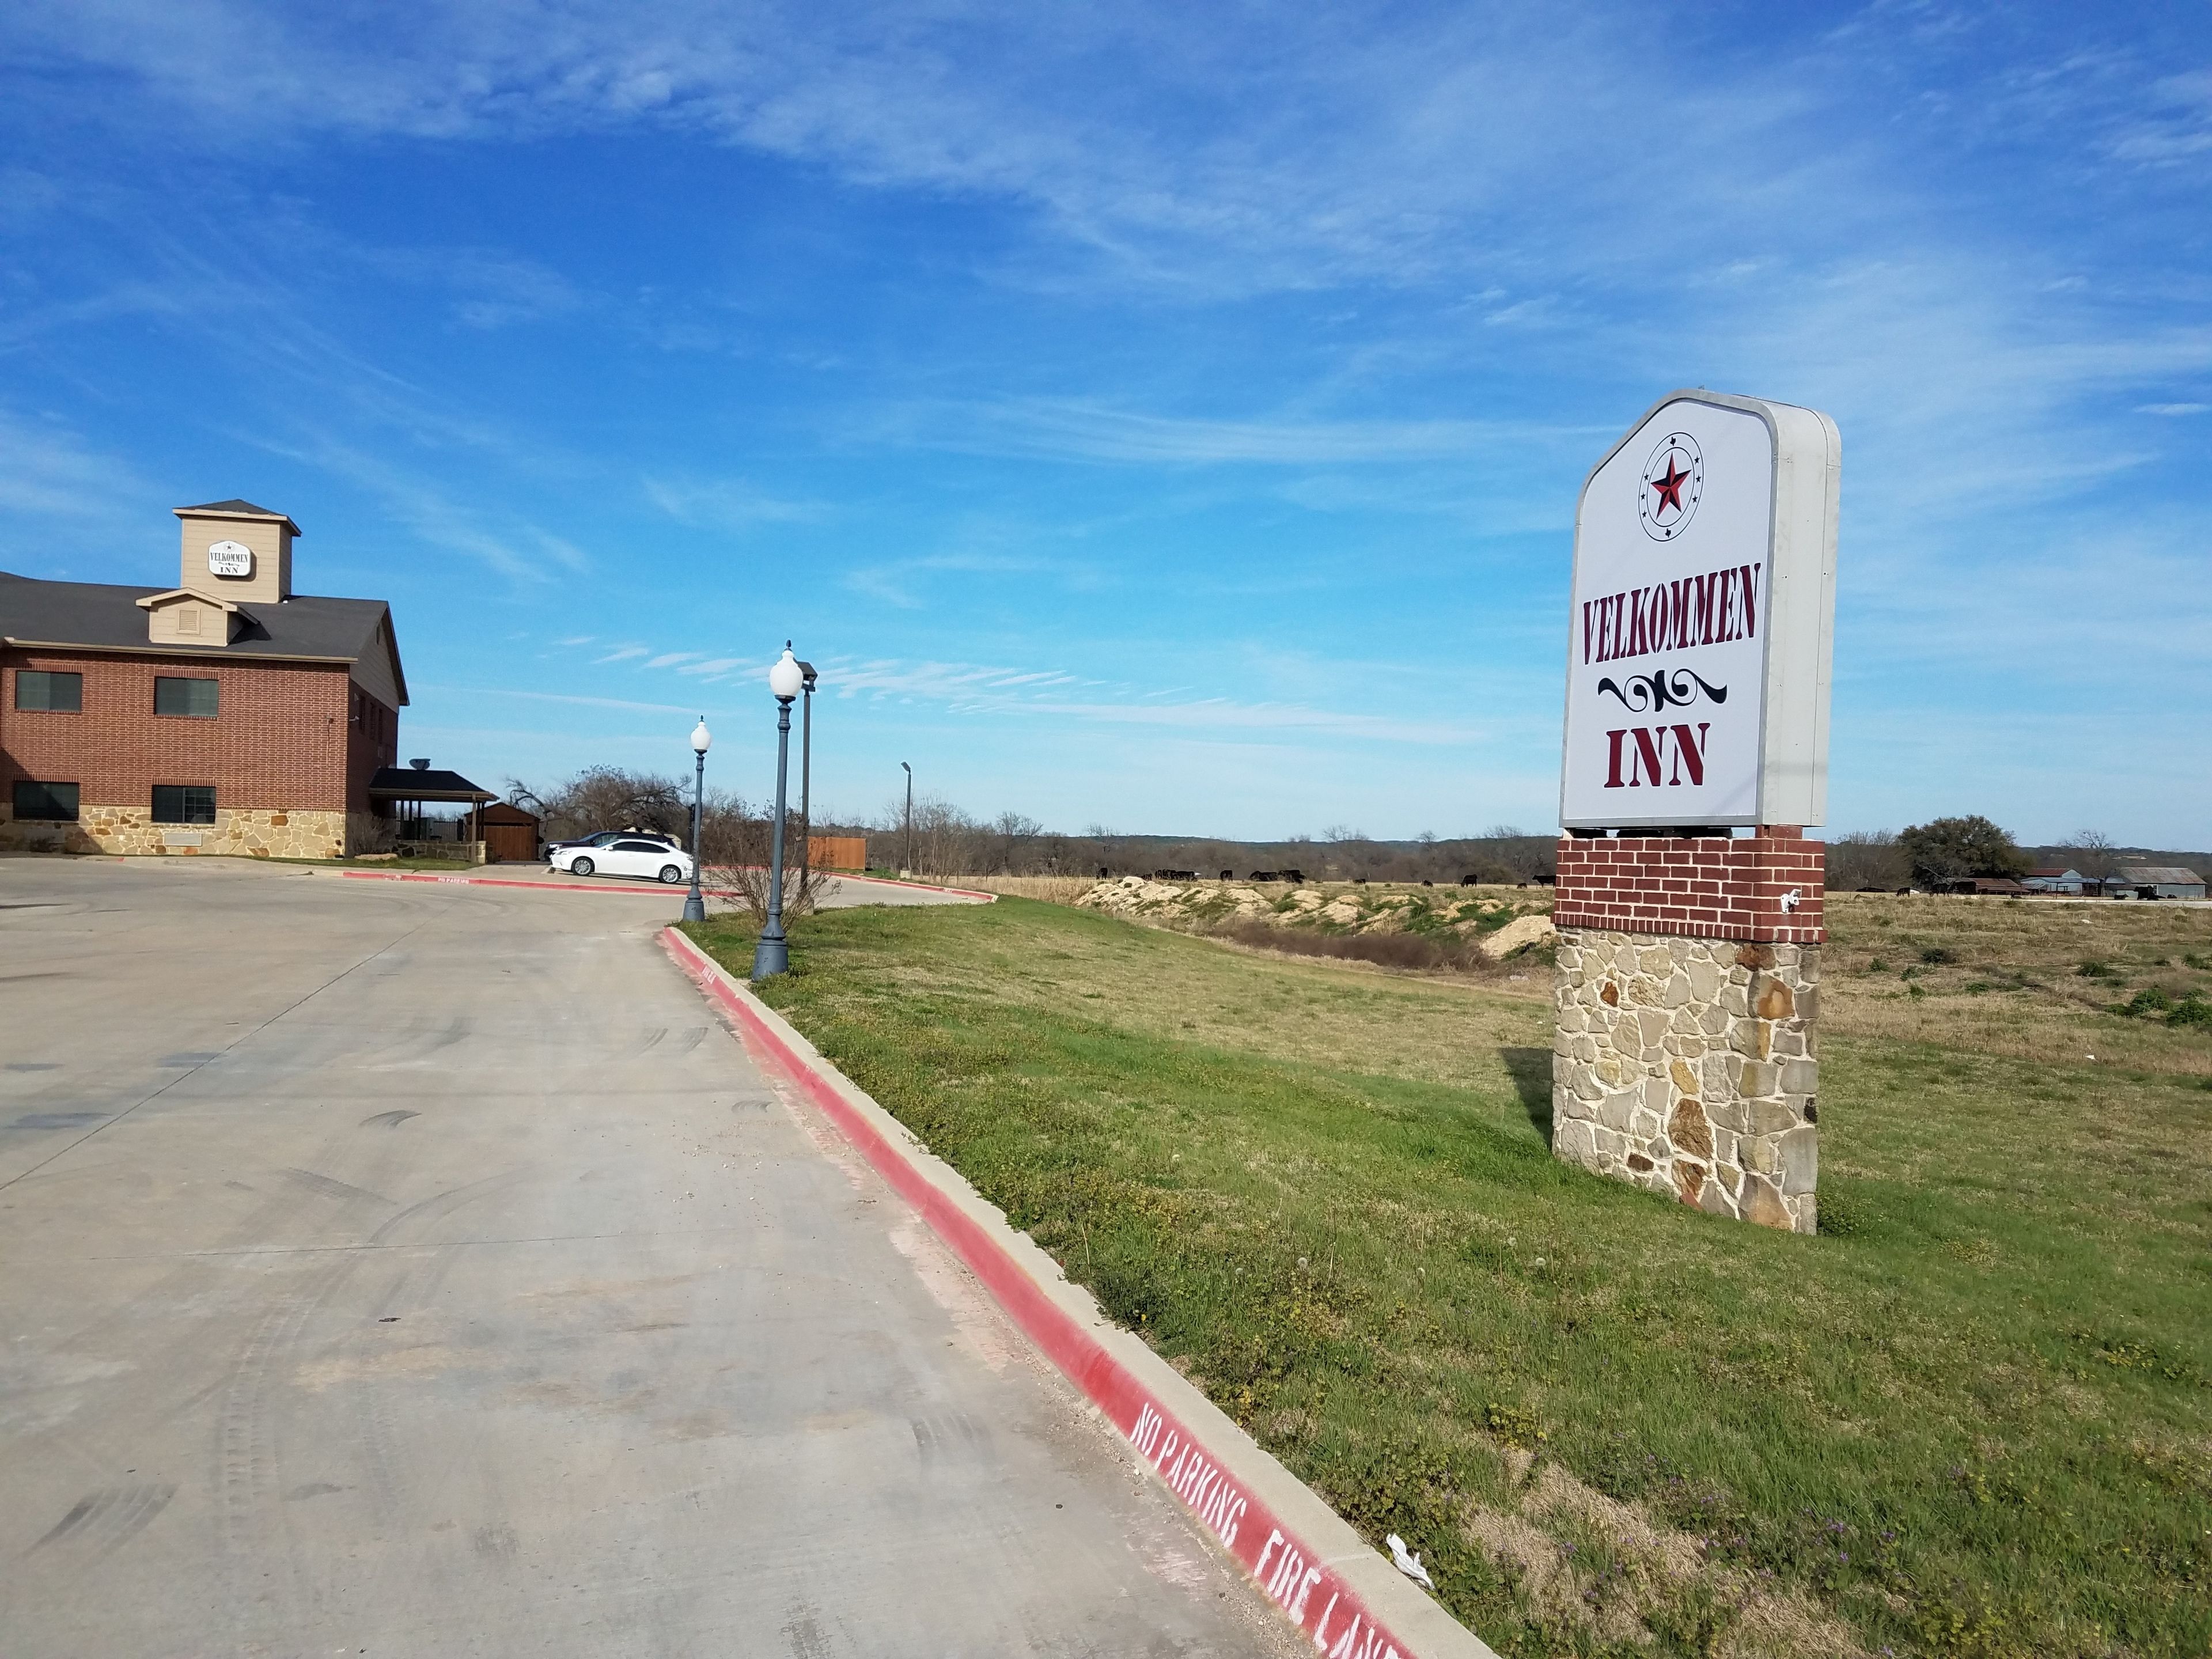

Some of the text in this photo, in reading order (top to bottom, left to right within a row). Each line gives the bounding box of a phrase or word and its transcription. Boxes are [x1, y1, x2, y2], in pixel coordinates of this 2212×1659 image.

[210, 552, 248, 562] VELKOMMEN
[1584, 563, 1760, 665] VELKOMMEN
[1604, 723, 1710, 787] INN
[1130, 1402, 1402, 1659] NO PARKING FIRE LAN
